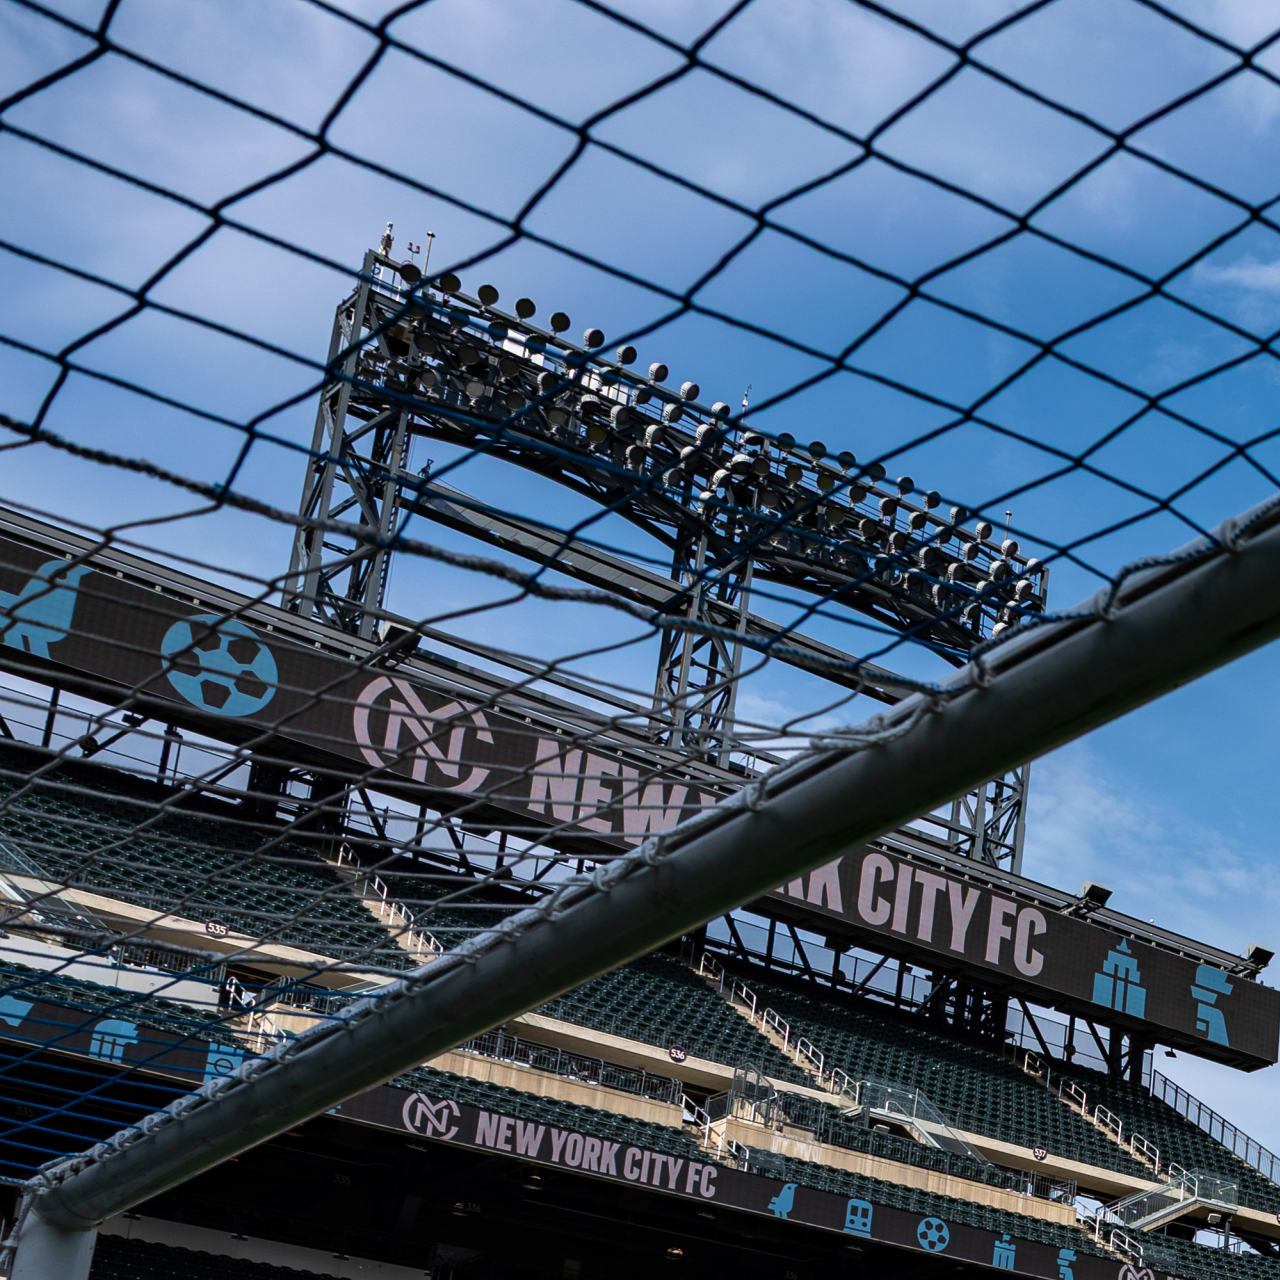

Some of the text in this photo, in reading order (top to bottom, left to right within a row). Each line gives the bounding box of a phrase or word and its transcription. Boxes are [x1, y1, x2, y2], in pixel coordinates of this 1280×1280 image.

[528, 737, 689, 845] NEW
[207, 922, 227, 935] 535
[858, 853, 980, 953] CITY
[985, 895, 1047, 977] FC
[671, 1049, 685, 1060] 536
[475, 1110, 718, 1198] NEW YORK CITY FC
